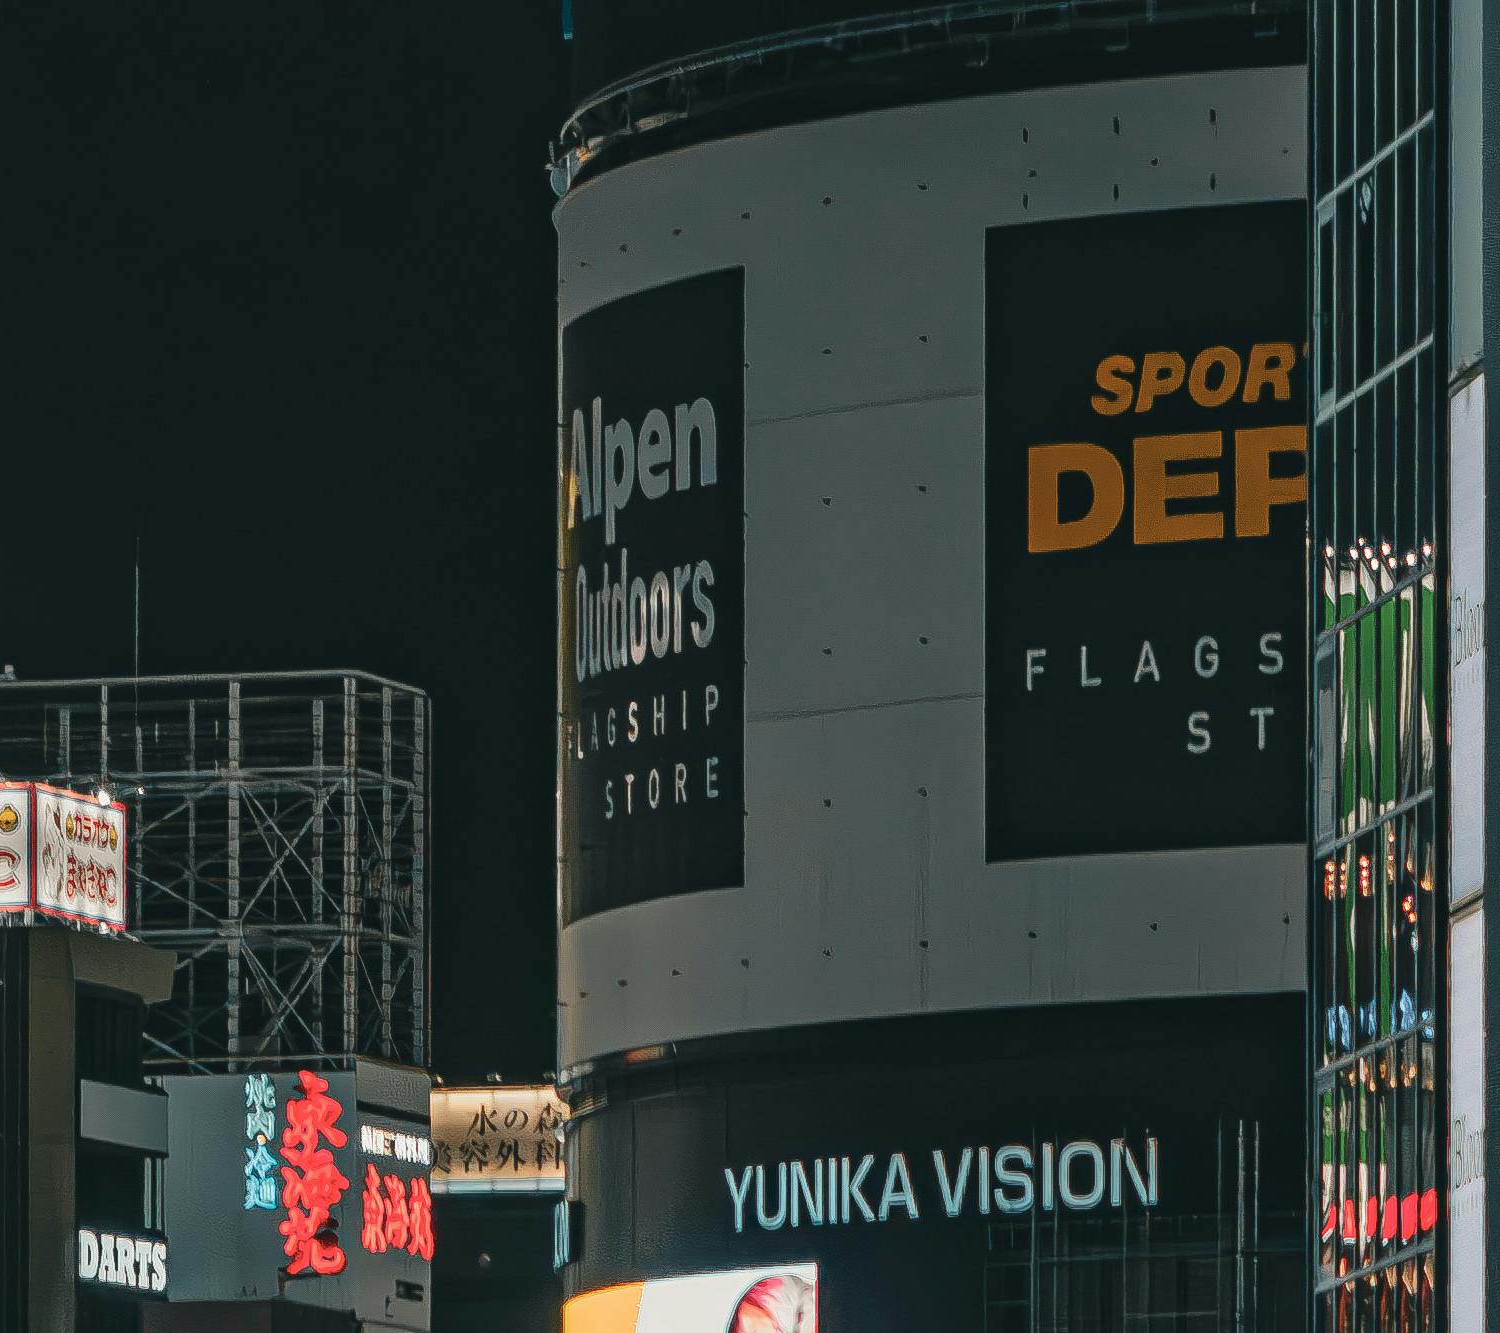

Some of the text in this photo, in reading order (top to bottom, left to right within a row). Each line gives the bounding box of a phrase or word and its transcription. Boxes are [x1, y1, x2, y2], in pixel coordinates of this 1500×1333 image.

[1091, 342, 1306, 416] SPOR
[567, 394, 719, 548] Alpen
[574, 555, 716, 686] Outdoors
[604, 755, 722, 820] STORE
[65, 854, 118, 905] まねきねこ
[723, 1136, 1161, 1234] YUNIKA VISION
[78, 1229, 168, 1292] DARTS
